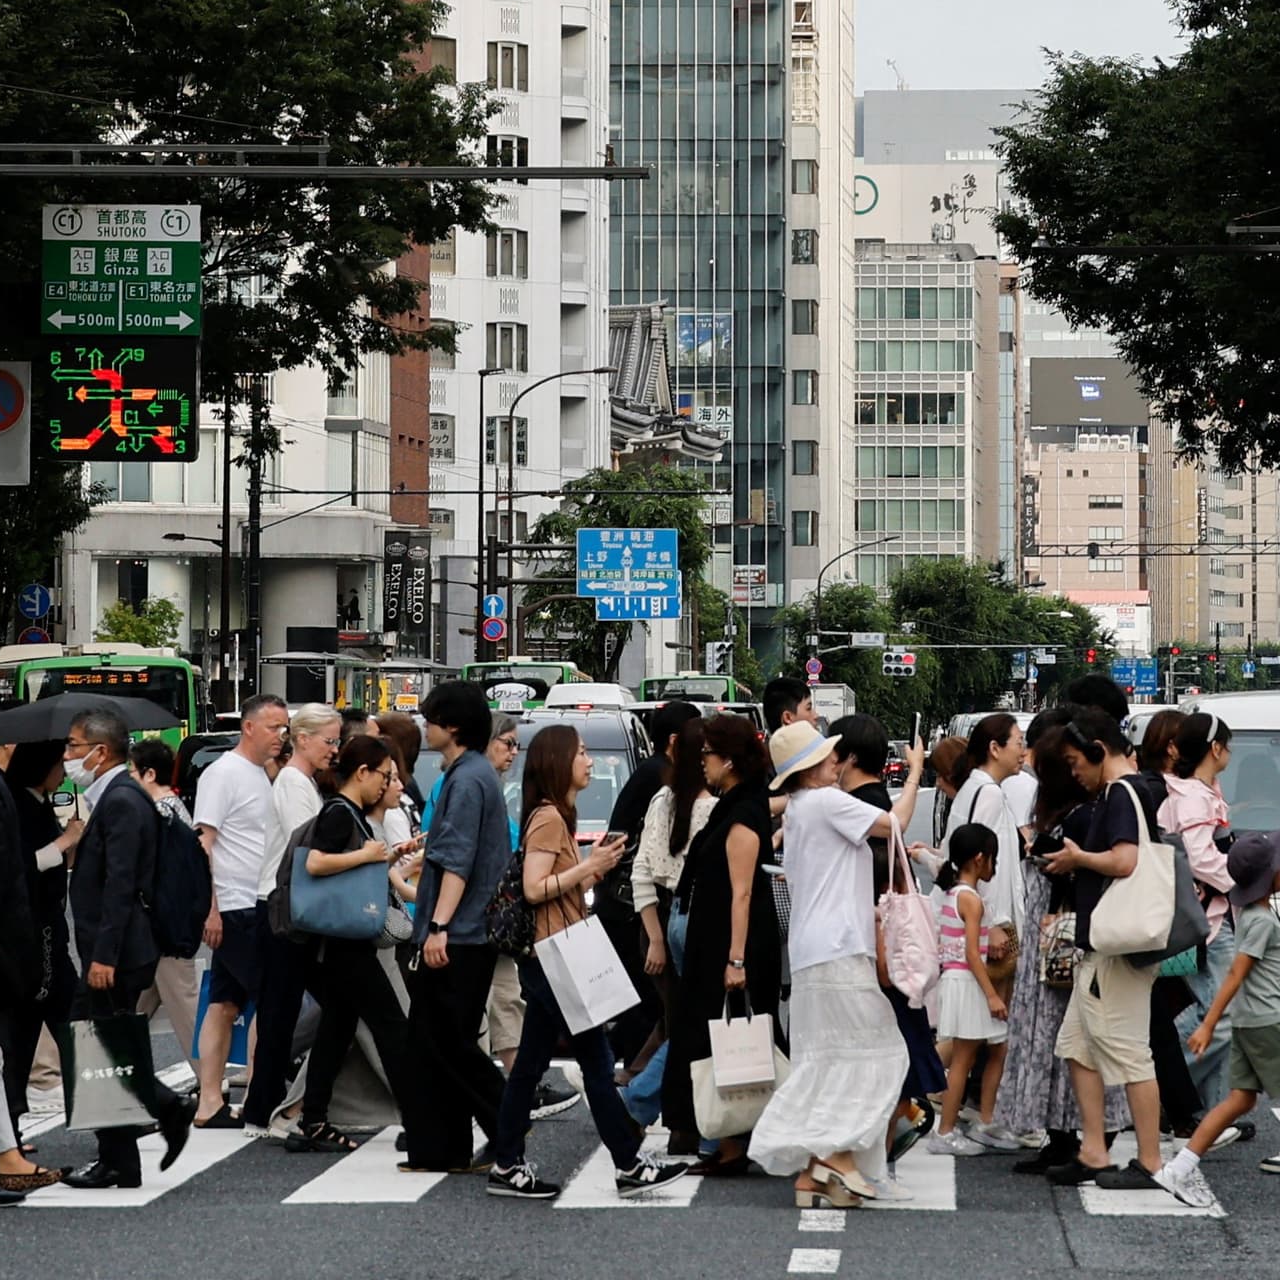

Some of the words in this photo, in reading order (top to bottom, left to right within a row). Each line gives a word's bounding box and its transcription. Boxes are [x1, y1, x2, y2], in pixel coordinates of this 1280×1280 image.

[58, 214, 75, 229] C1
[97, 209, 147, 225] 首都高
[166, 215, 183, 231] C1
[97, 226, 146, 238] SHUTOKO
[73, 250, 93, 260] 入口
[104, 248, 139, 262] 銀座
[149, 251, 170, 260] 入口
[76, 263, 89, 272] 15
[104, 264, 139, 276] Ginza
[153, 263, 166, 273] 16
[48, 285, 64, 296] E4
[69, 281, 116, 292] 東北道方面
[129, 286, 145, 297] E1
[150, 282, 196, 293] 東名方面
[69, 293, 97, 301] TOHOKU
[99, 293, 113, 301] EXP
[150, 293, 175, 302] TOMEI
[177, 294, 192, 302] EXP
[78, 314, 115, 326] 500m
[126, 314, 163, 326] 500m
[50, 352, 61, 365] 6
[124, 411, 140, 425] C1
[698, 408, 731, 421] 海外
[50, 420, 61, 434] 5
[116, 441, 127, 453] 4
[175, 441, 186, 453] 3
[388, 563, 402, 619] EXELCO
[413, 568, 425, 624] EXELCO
[495, 690, 525, 698] グリーン
[510, 1172, 530, 1188] N
[640, 1168, 660, 1182] N
